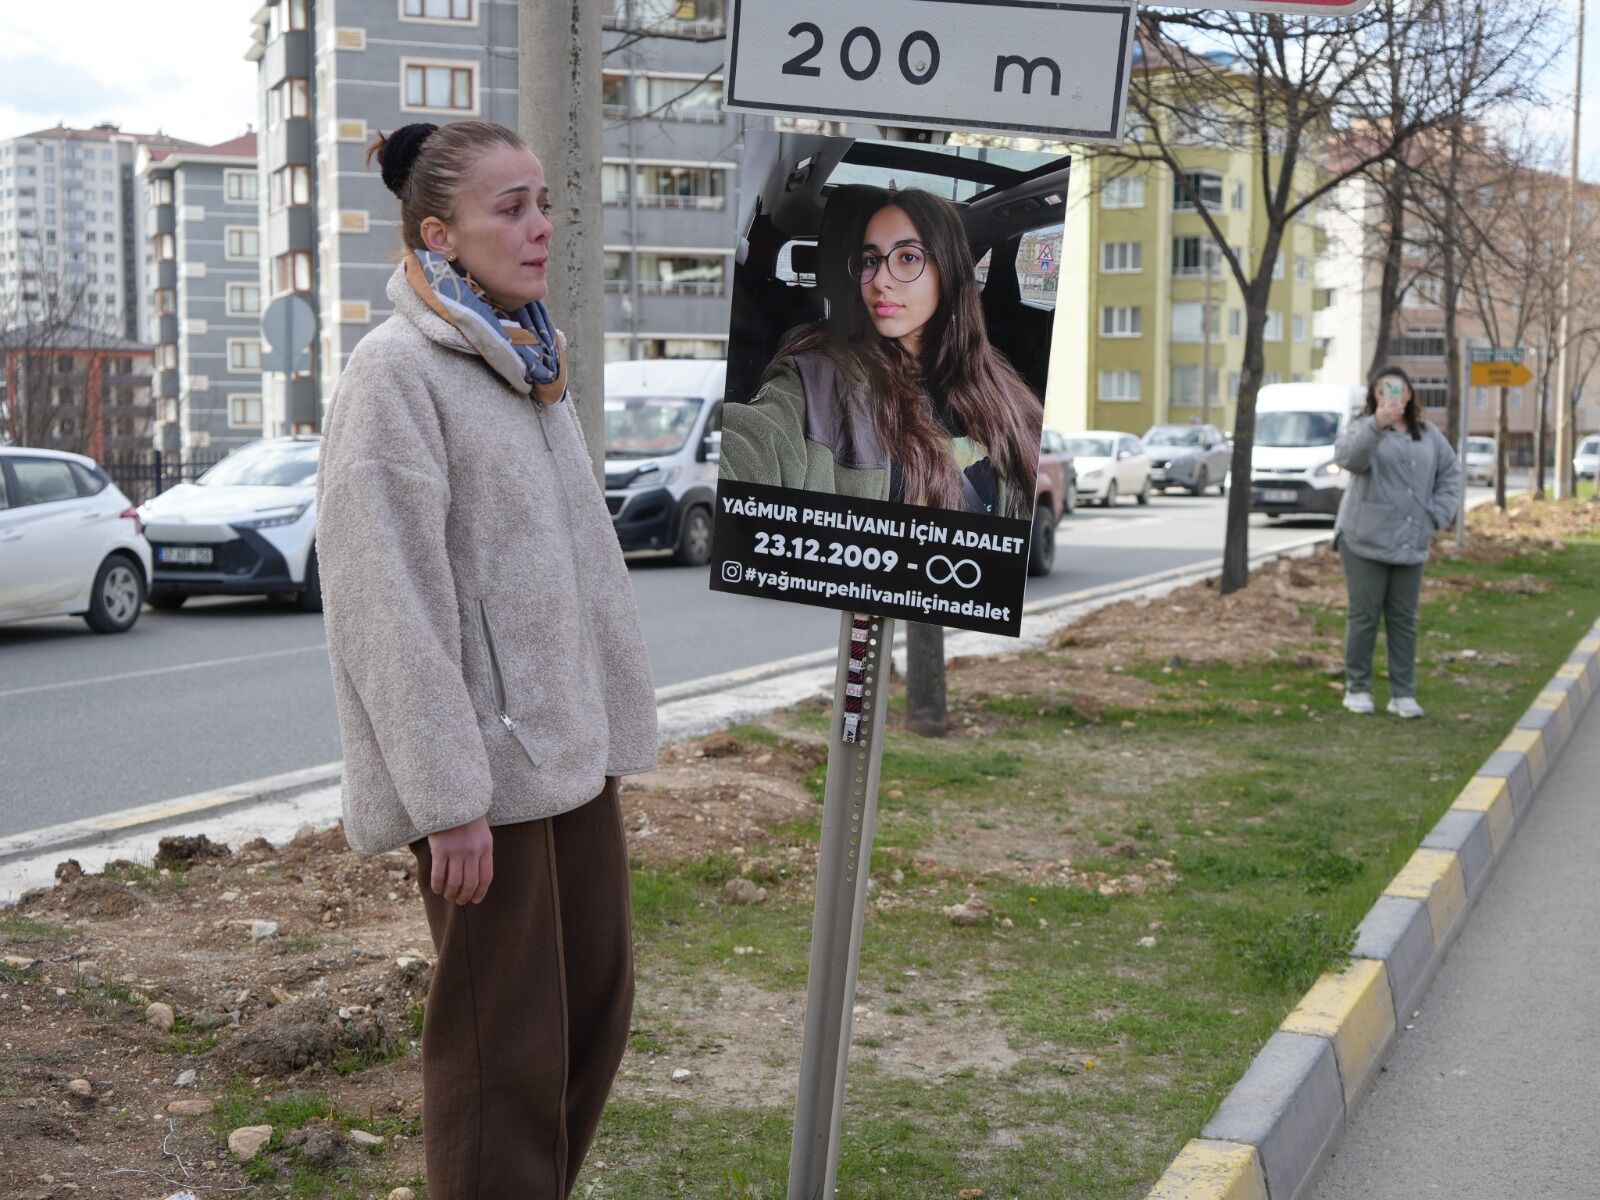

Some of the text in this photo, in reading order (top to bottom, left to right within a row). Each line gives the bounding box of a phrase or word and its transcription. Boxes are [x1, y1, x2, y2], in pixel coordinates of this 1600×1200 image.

[781, 21, 1062, 96] 200 m
[722, 496, 1024, 554] YAĞMUR PEHLİVANLI İÇİN ADALET
[754, 531, 899, 573] 23.12.2009
[744, 567, 1011, 622] #yağmurpehlivanliiçinadalet
